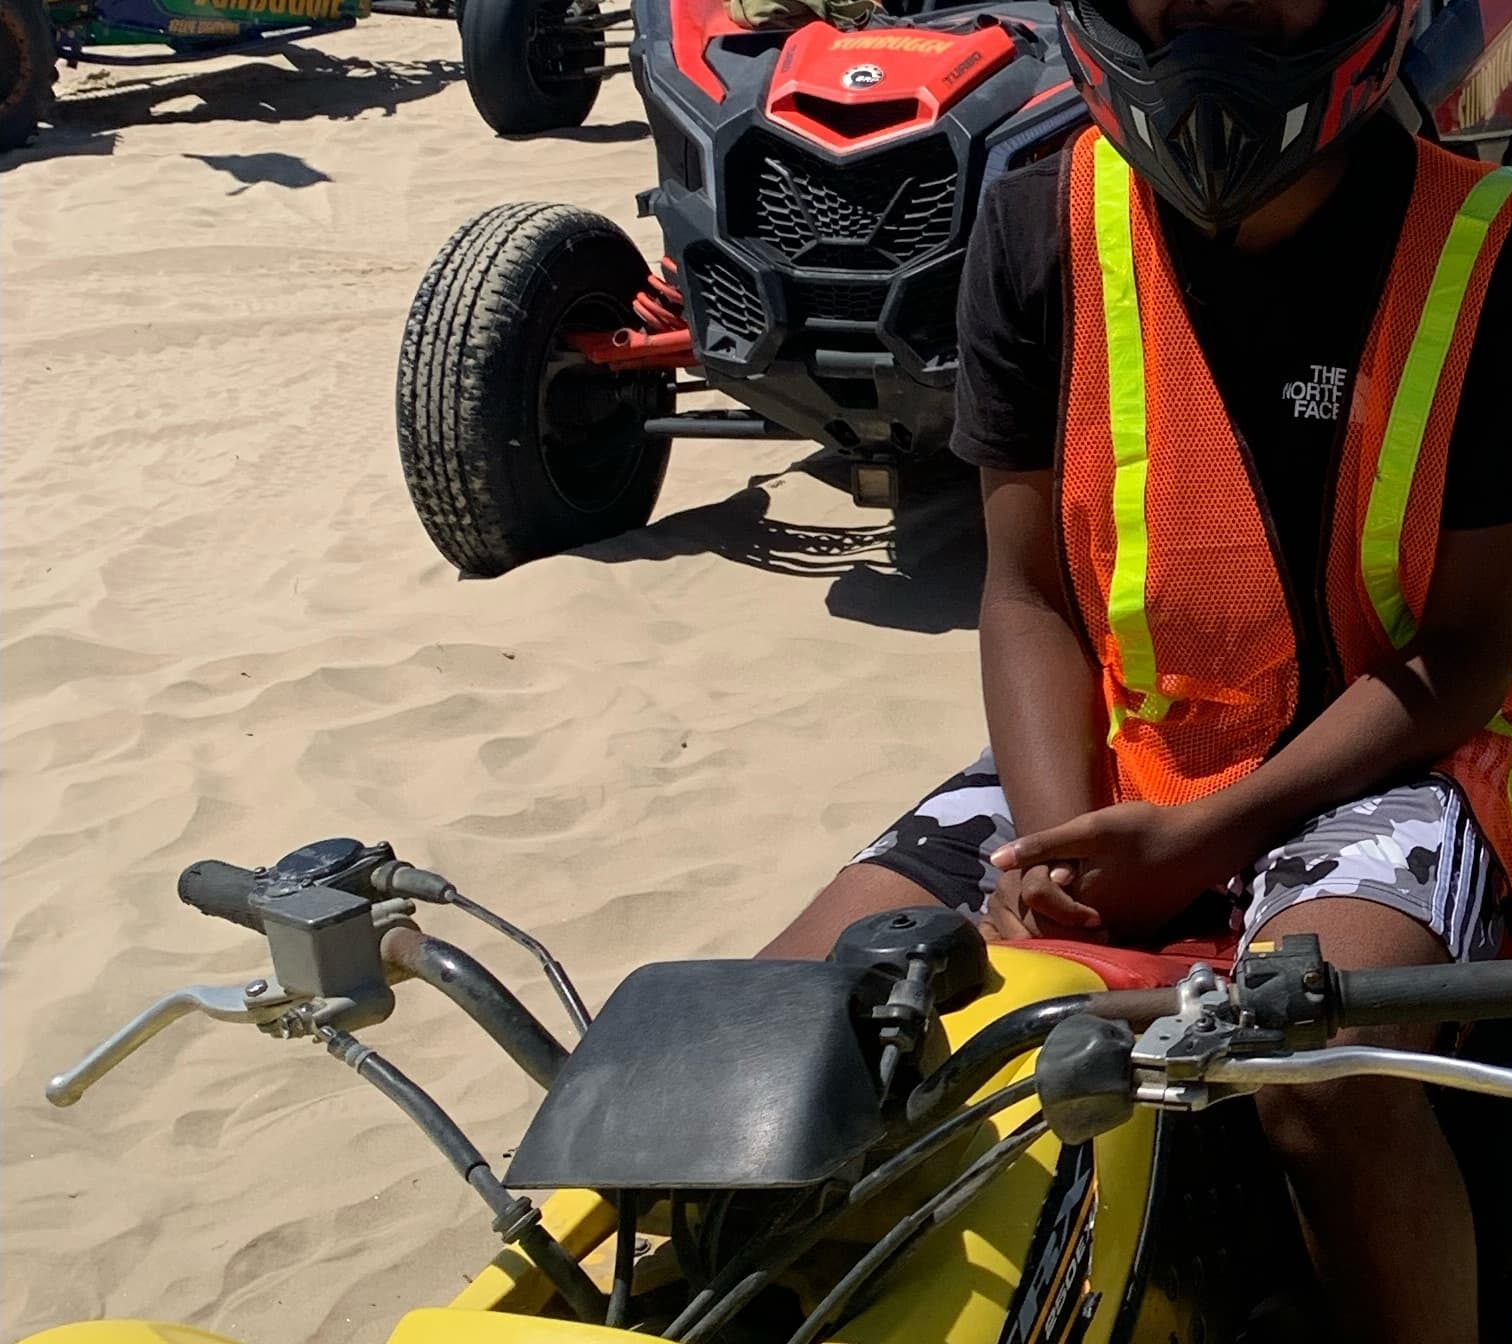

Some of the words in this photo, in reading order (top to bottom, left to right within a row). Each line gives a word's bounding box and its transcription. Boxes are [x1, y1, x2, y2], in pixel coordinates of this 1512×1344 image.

[942, 51, 983, 86] TURBO
[1310, 364, 1347, 386] THE
[1281, 380, 1342, 402] NORTH
[1293, 400, 1340, 420] FACE
